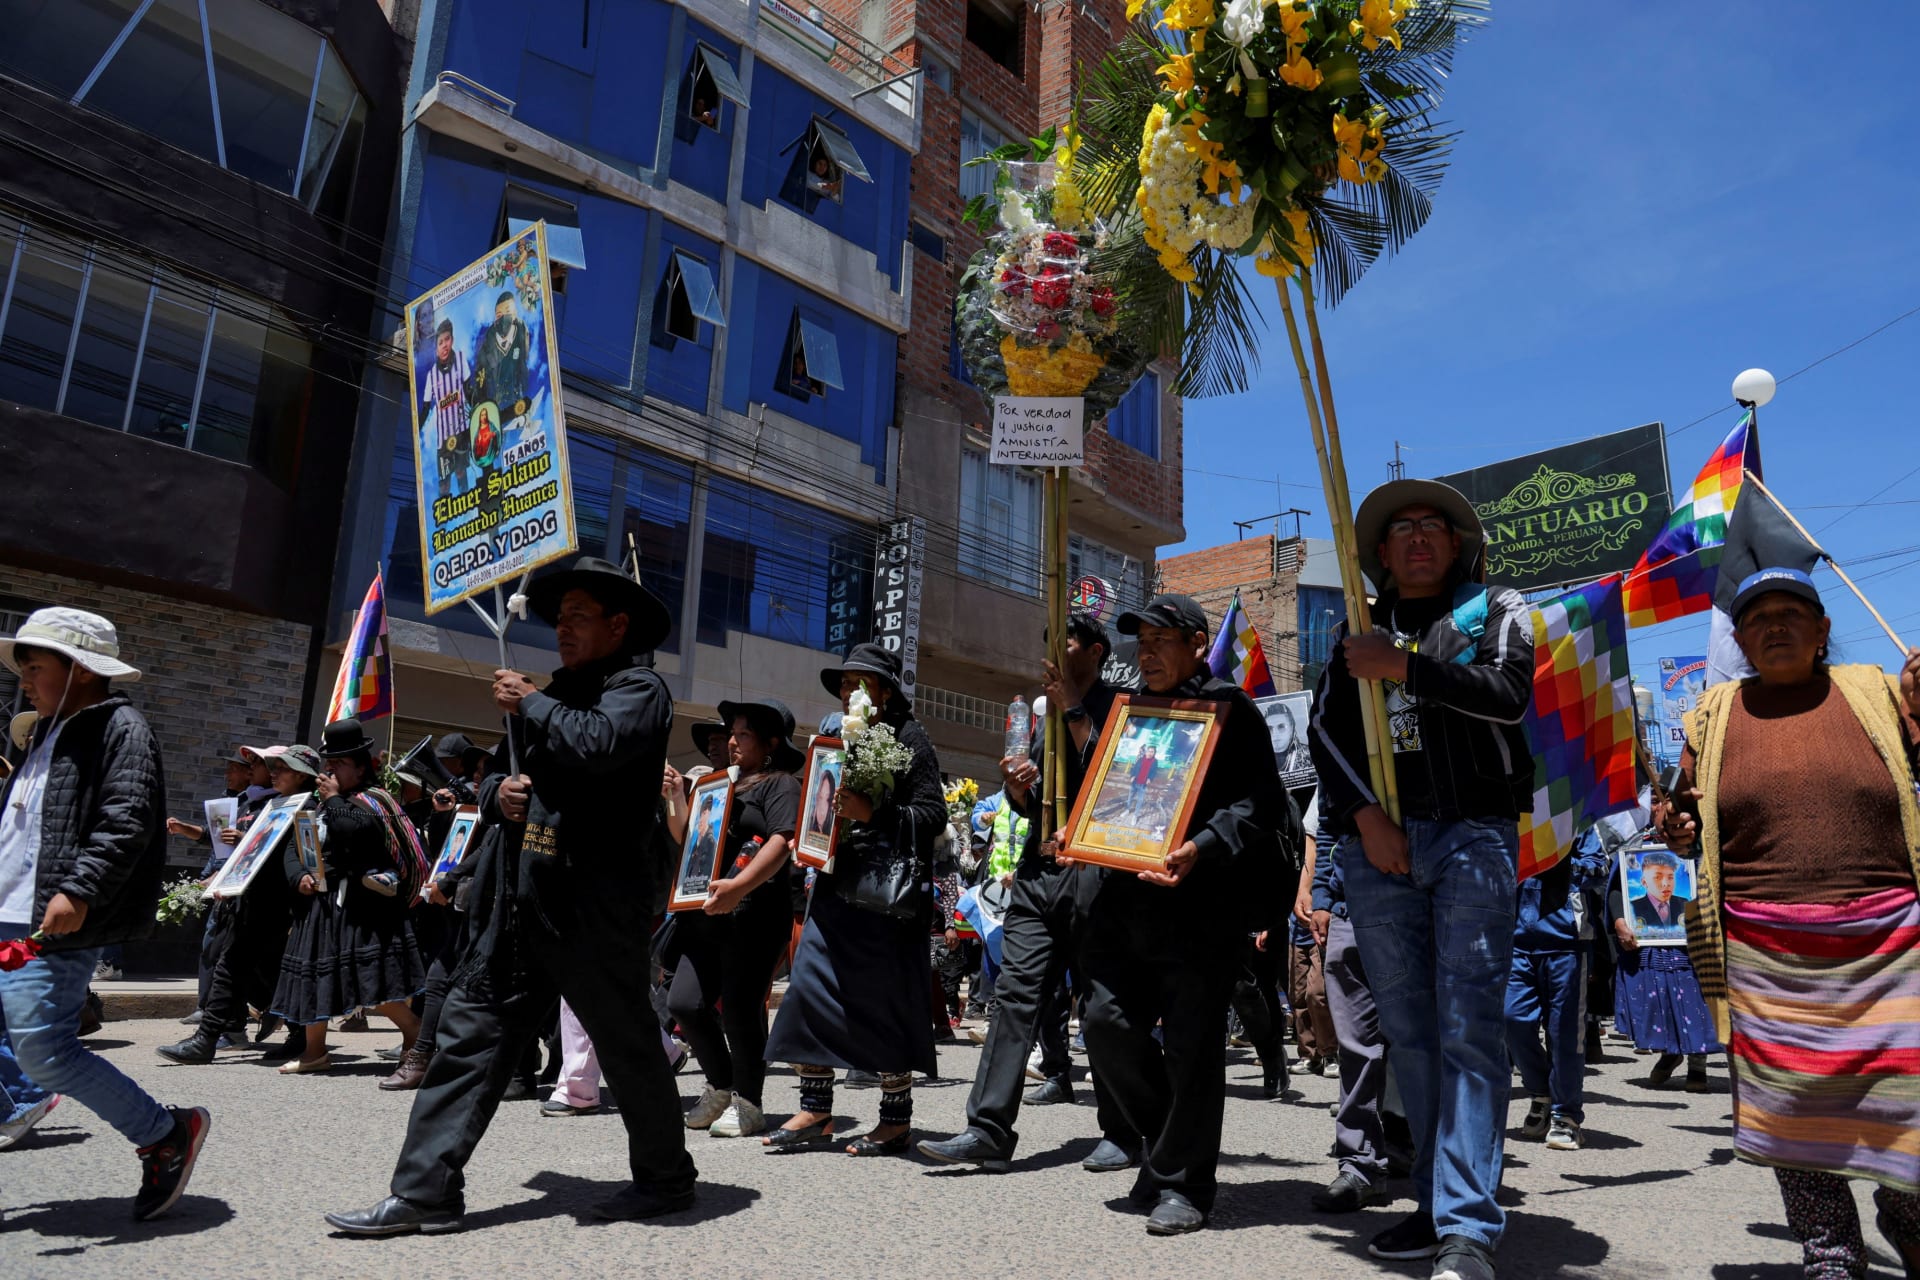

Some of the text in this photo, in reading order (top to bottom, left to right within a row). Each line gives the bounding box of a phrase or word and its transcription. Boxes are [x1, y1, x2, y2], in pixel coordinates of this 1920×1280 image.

[504, 435, 546, 466] 16 AÑOS
[997, 450, 1083, 461] INTERNACIONAL
[999, 436, 1069, 447] AMNISTÍA
[433, 487, 482, 526] Elmer
[487, 450, 551, 500] Solano
[433, 480, 558, 553] Leonardo Huanca
[1487, 492, 1649, 546] NTUARIO
[434, 511, 557, 587] Q.E.P.D. Y D.D.G
[1501, 525, 1606, 554] COMIDA PERUANA
[1678, 696, 1688, 712] 9
[544, 826, 556, 836] DE
